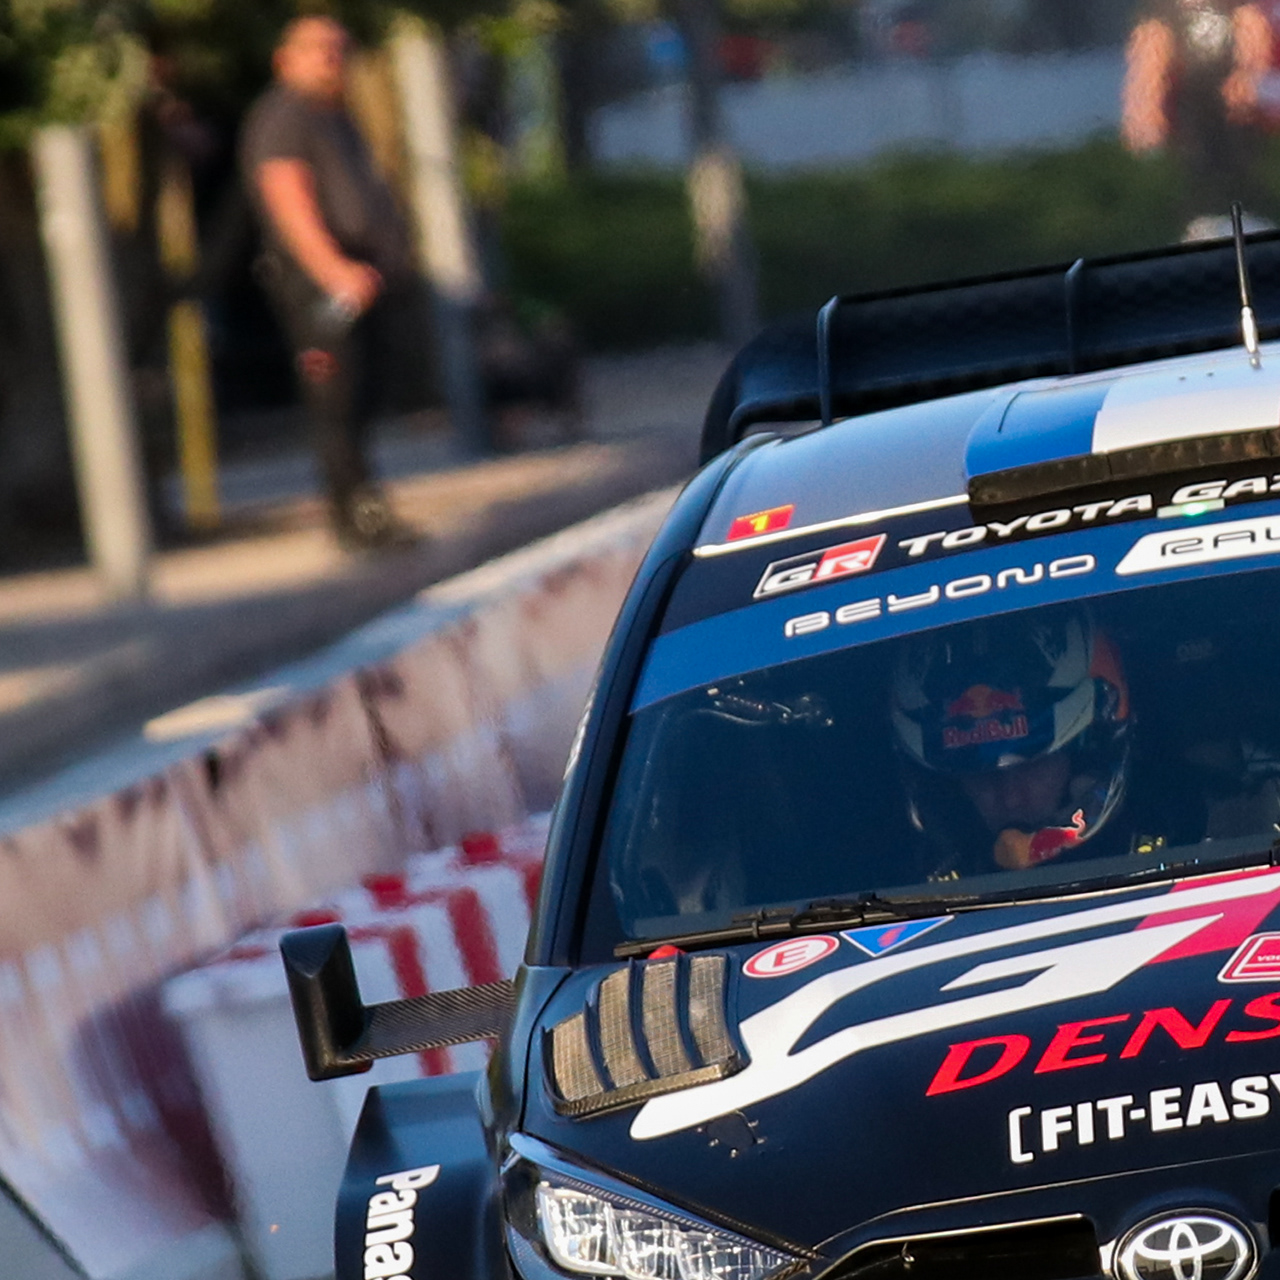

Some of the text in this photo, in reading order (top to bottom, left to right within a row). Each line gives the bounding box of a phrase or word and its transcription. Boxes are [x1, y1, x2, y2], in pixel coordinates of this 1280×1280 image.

[765, 547, 874, 594] GR
[898, 494, 1153, 557] TOYOTA
[784, 553, 1097, 638] BEYOND
